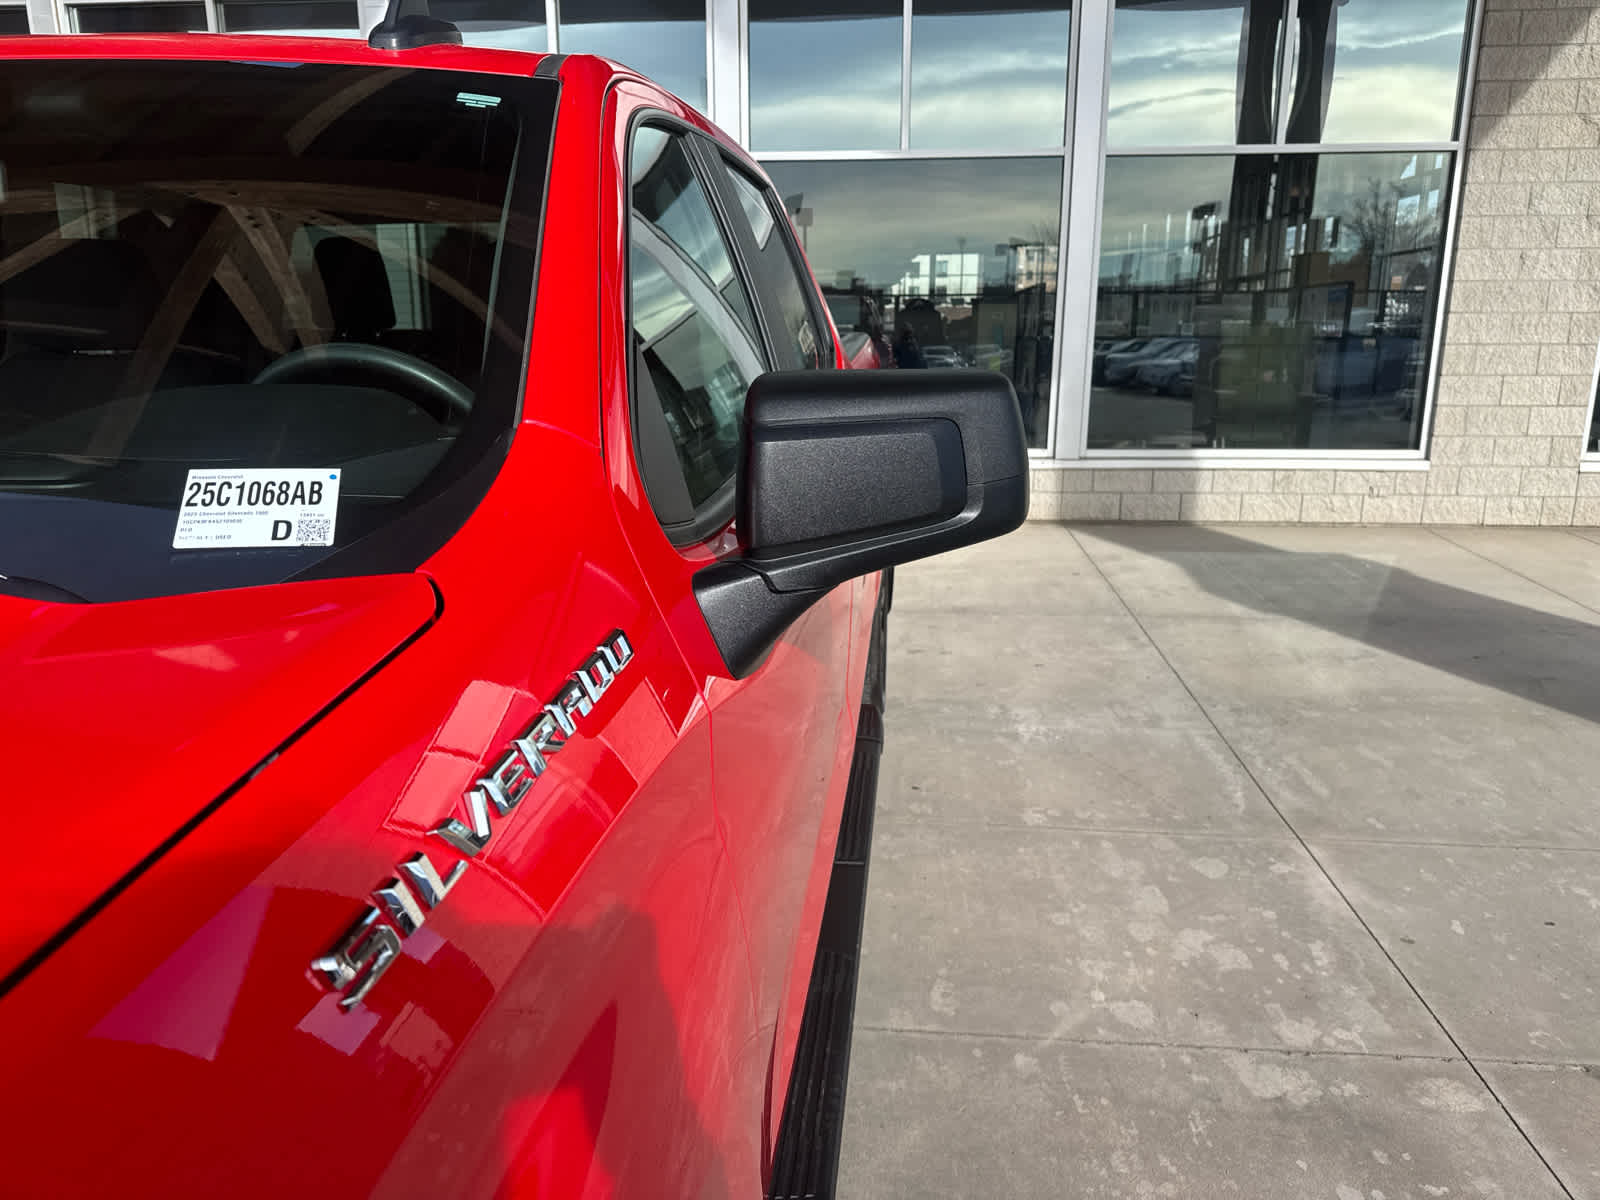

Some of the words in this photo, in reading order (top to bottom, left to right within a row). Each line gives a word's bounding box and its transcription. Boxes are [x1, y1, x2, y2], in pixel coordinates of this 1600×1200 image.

[184, 480, 323, 507] 25C1068AB
[271, 520, 292, 541] D
[310, 627, 635, 1013] SILVERADO
